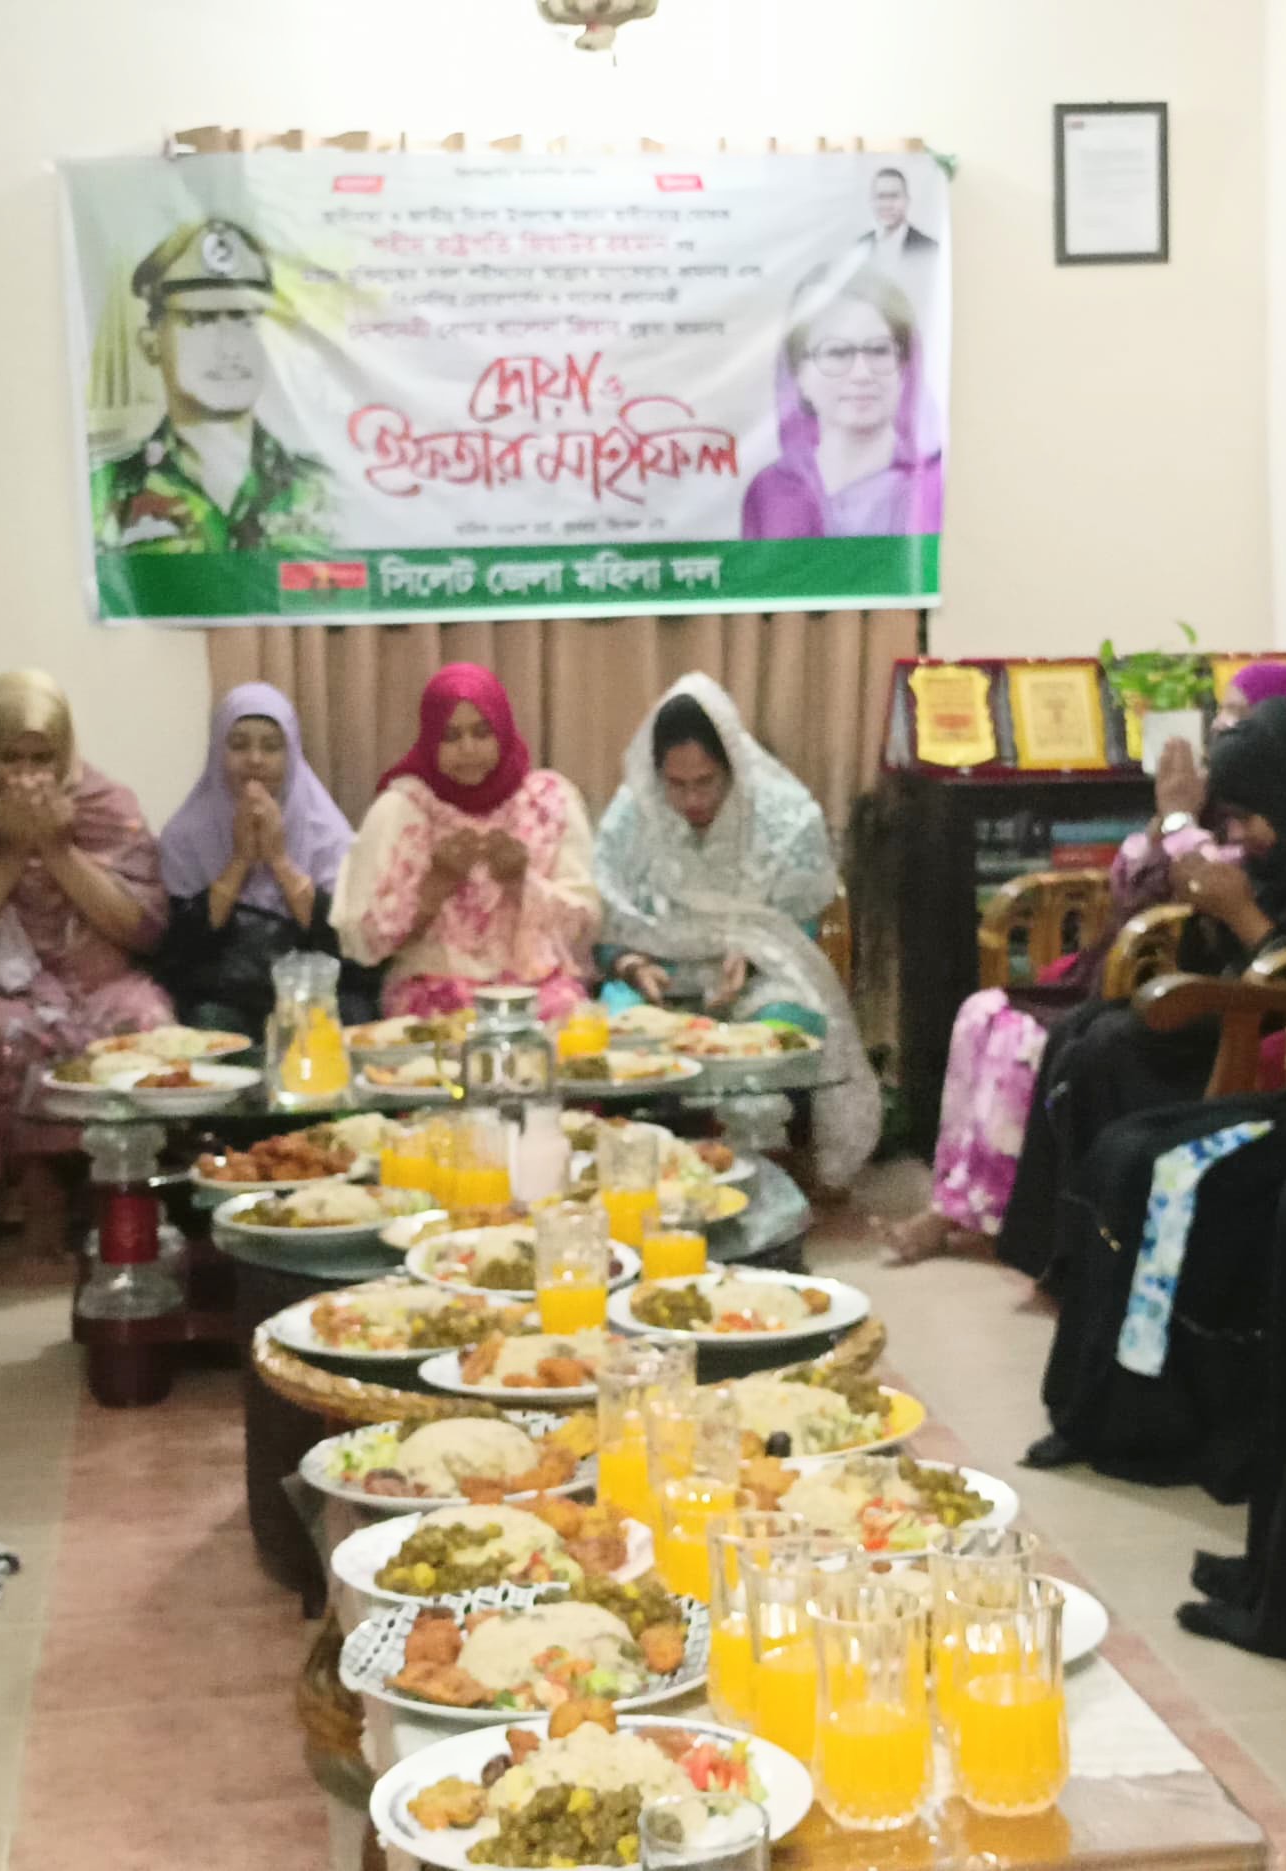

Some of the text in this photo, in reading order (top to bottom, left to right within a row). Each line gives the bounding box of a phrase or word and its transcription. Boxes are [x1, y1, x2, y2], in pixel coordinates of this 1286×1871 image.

[468, 351, 602, 424] দোয়া
[347, 395, 740, 506] ইফতার মাহফিল
[379, 550, 722, 598] সিলেট জেলা মহিলা দল
